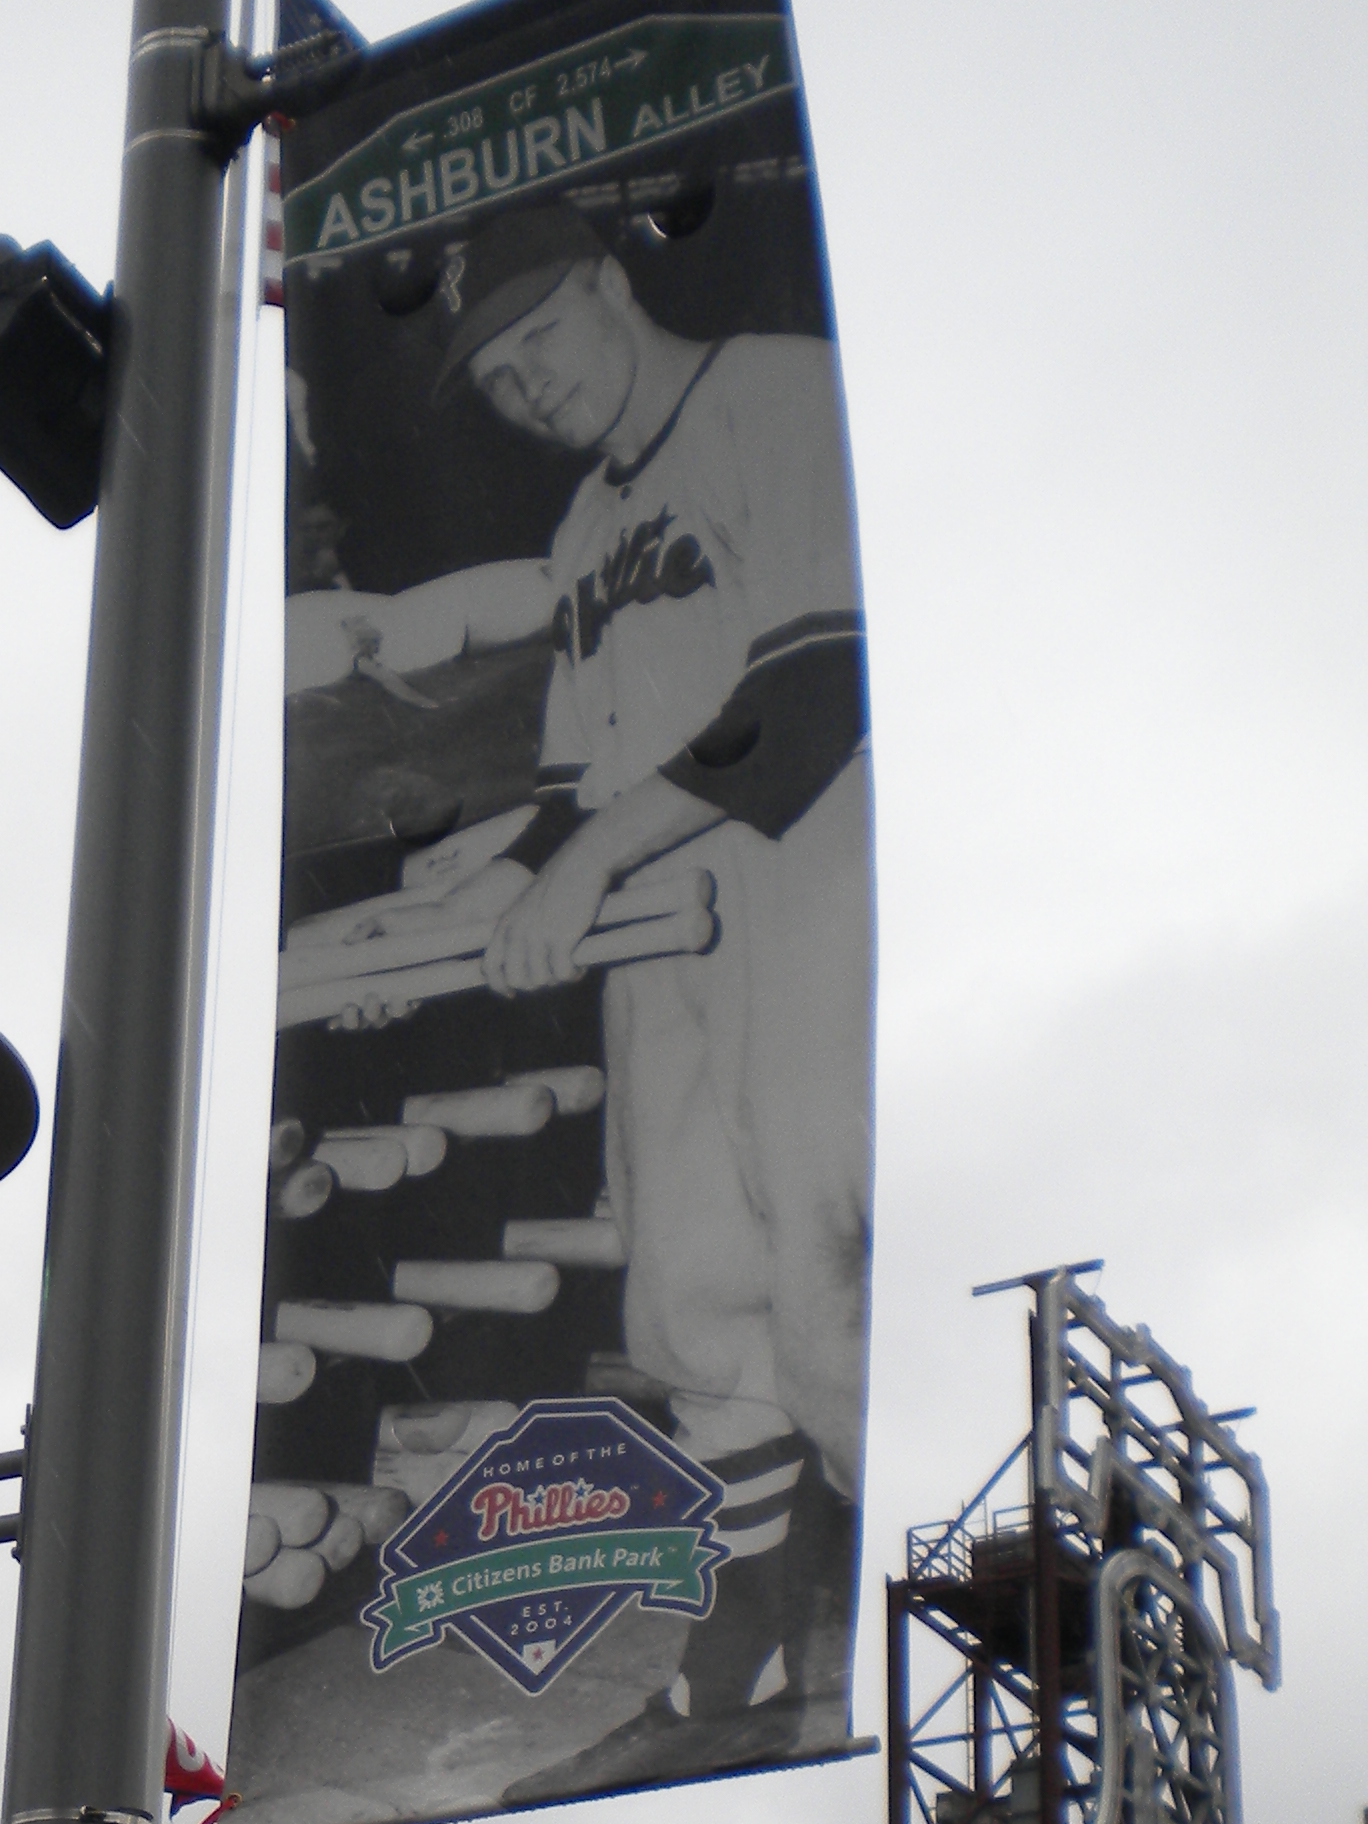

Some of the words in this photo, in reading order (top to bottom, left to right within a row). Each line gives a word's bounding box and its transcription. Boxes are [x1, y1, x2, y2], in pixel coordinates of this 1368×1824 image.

[316, 98, 607, 249] ASHBURN
[633, 54, 770, 138] ALLEY
[482, 1457, 544, 1478] HOME
[551, 1452, 579, 1467] OF
[585, 1442, 628, 1460] THE
[471, 1478, 631, 1542] Phillies
[451, 1558, 543, 1597] Citizens
[548, 1548, 606, 1576] Bank
[612, 1546, 663, 1568] Park
[510, 1614, 574, 1636] 2004
[521, 1600, 569, 1617] EST.
